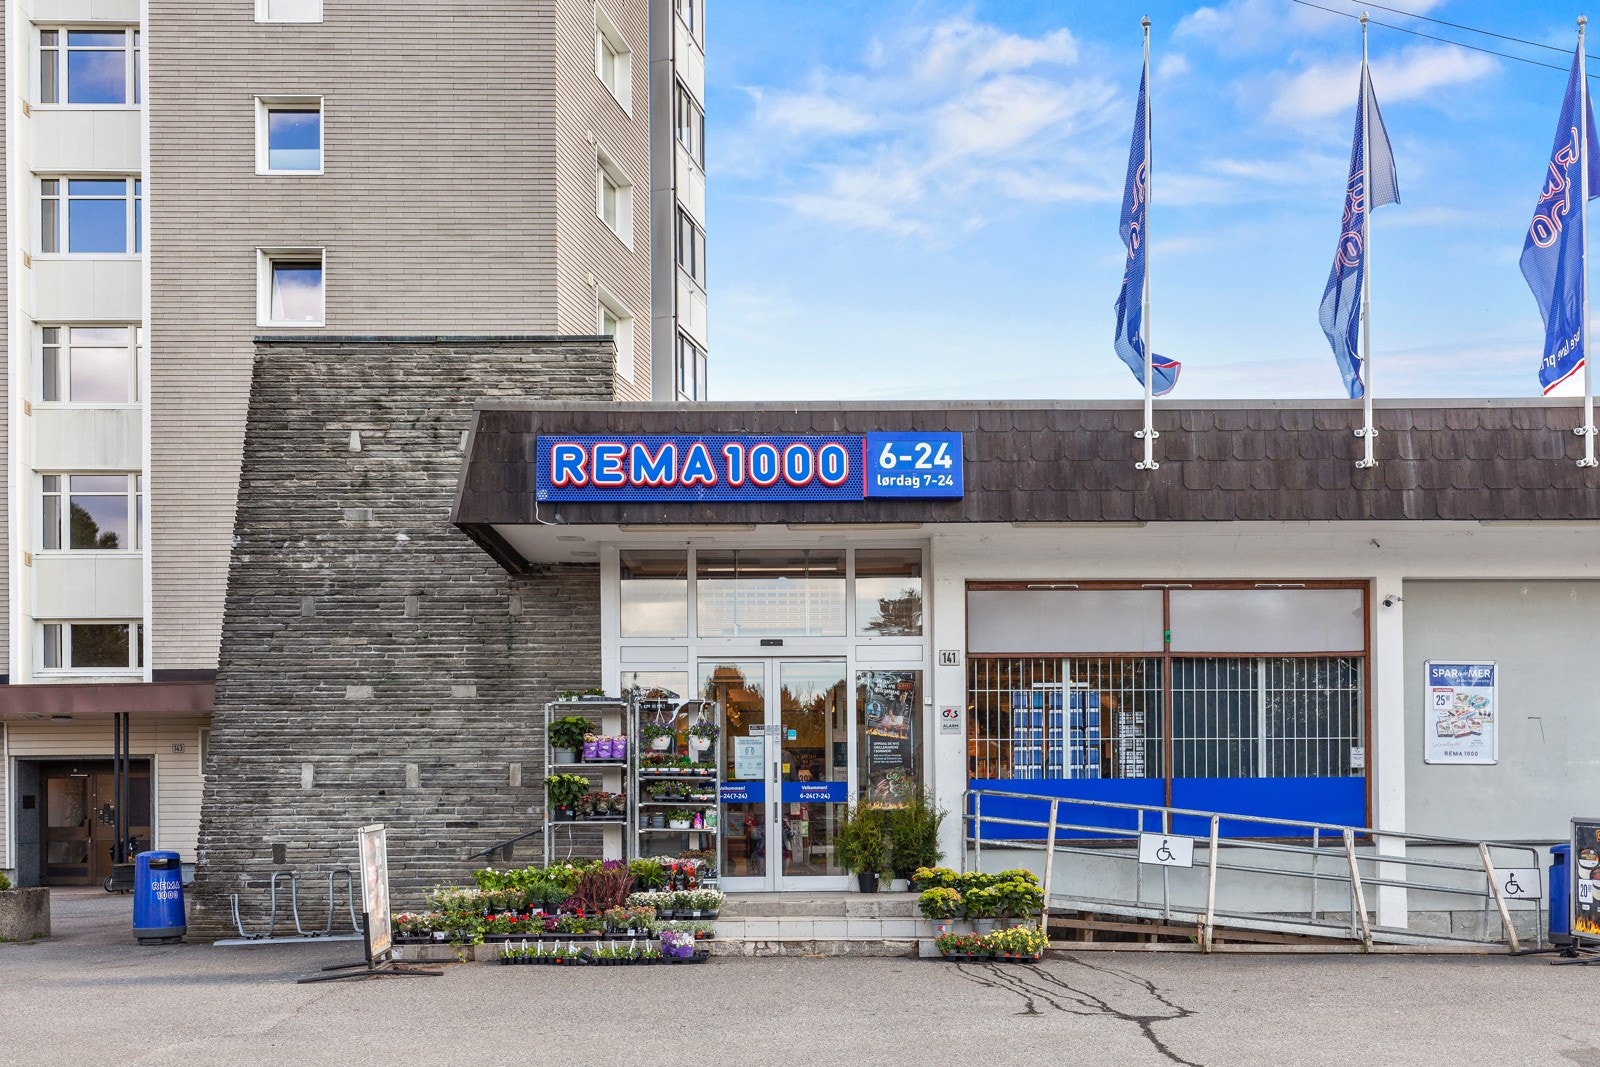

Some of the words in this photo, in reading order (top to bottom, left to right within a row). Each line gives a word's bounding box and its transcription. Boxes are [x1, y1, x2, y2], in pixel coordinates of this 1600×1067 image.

[878, 441, 954, 470] 6-24
[551, 441, 717, 488] REMA
[722, 441, 849, 488] 1000
[877, 474, 921, 489] lørdag
[924, 475, 954, 487] 7-24
[942, 652, 956, 664] 141
[1432, 668, 1458, 678] SPAR
[1467, 669, 1491, 678] MER
[151, 881, 181, 891] REMA
[156, 891, 179, 900] 1000
